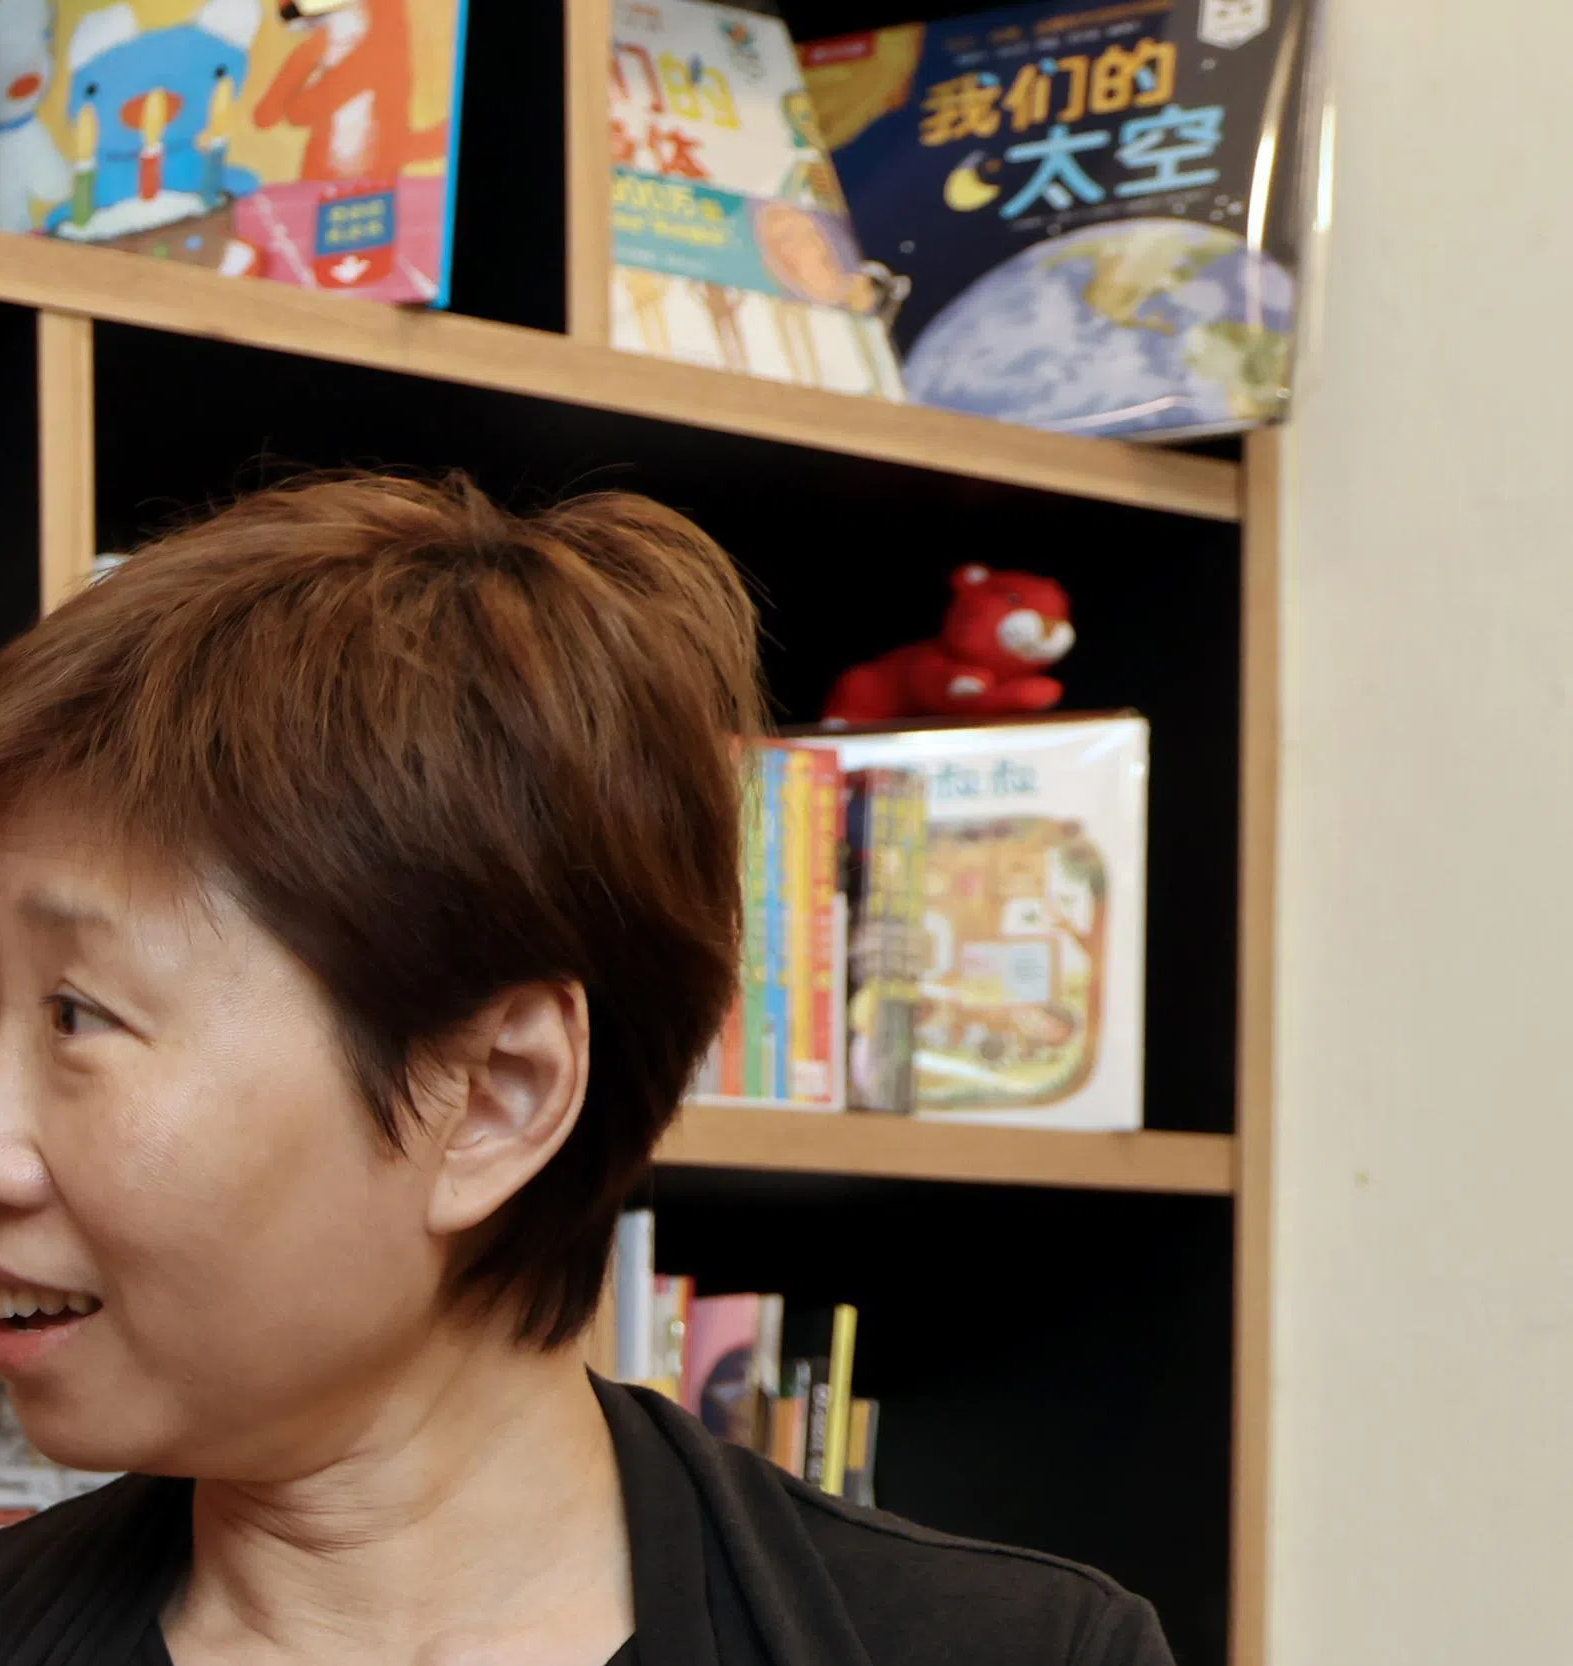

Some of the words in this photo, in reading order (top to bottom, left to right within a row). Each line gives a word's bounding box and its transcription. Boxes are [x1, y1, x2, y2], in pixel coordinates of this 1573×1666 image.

[918, 37, 1179, 147] 我们的
[997, 103, 1227, 220] 太空
